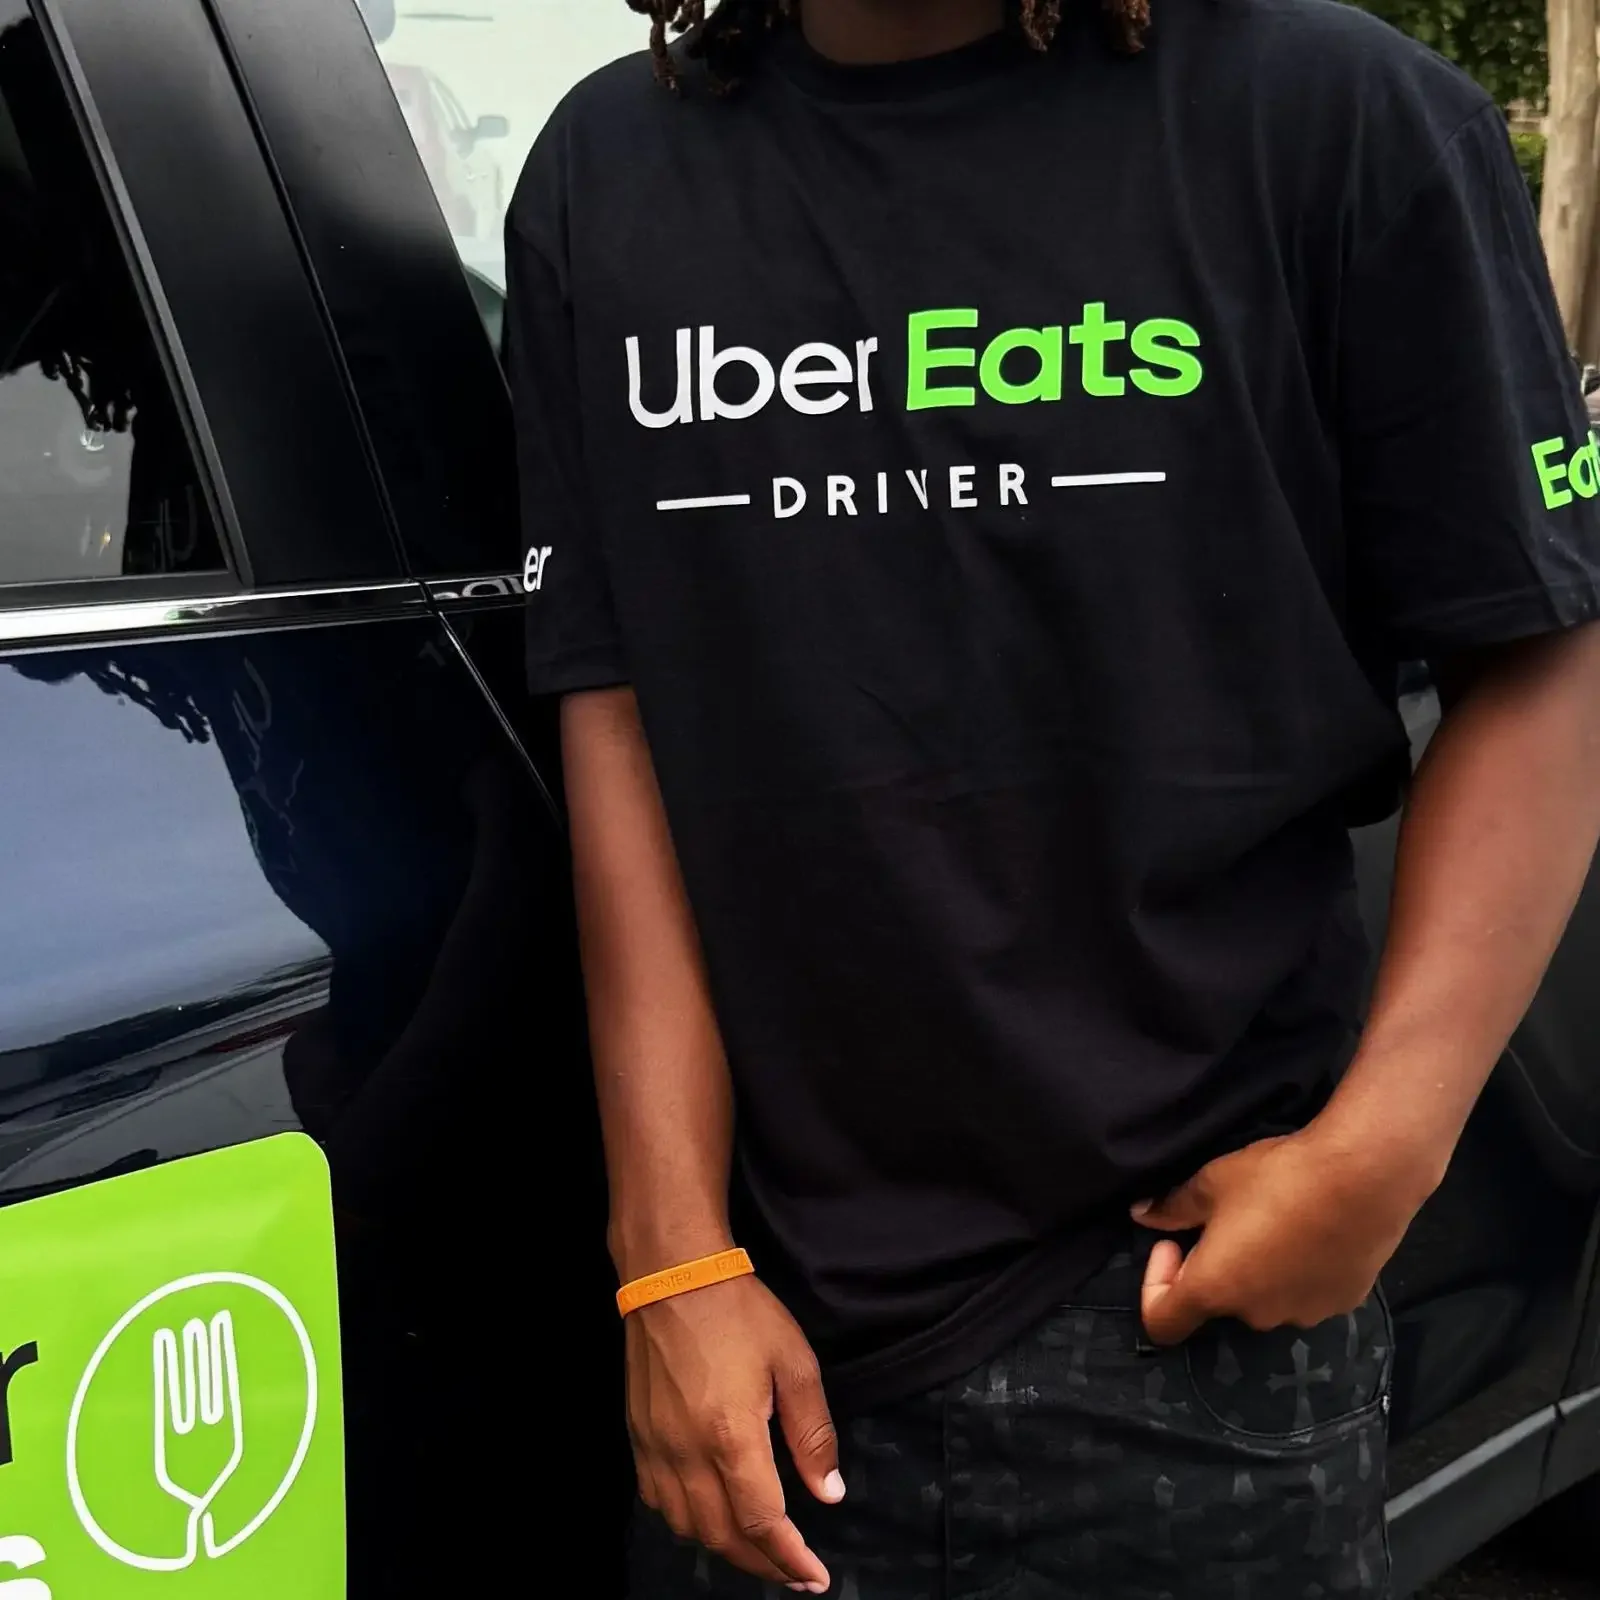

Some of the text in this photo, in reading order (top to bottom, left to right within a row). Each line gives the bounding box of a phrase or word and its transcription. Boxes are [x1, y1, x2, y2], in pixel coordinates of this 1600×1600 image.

[625, 301, 1203, 429] Uber Eats
[772, 463, 1029, 519] DRIVER
